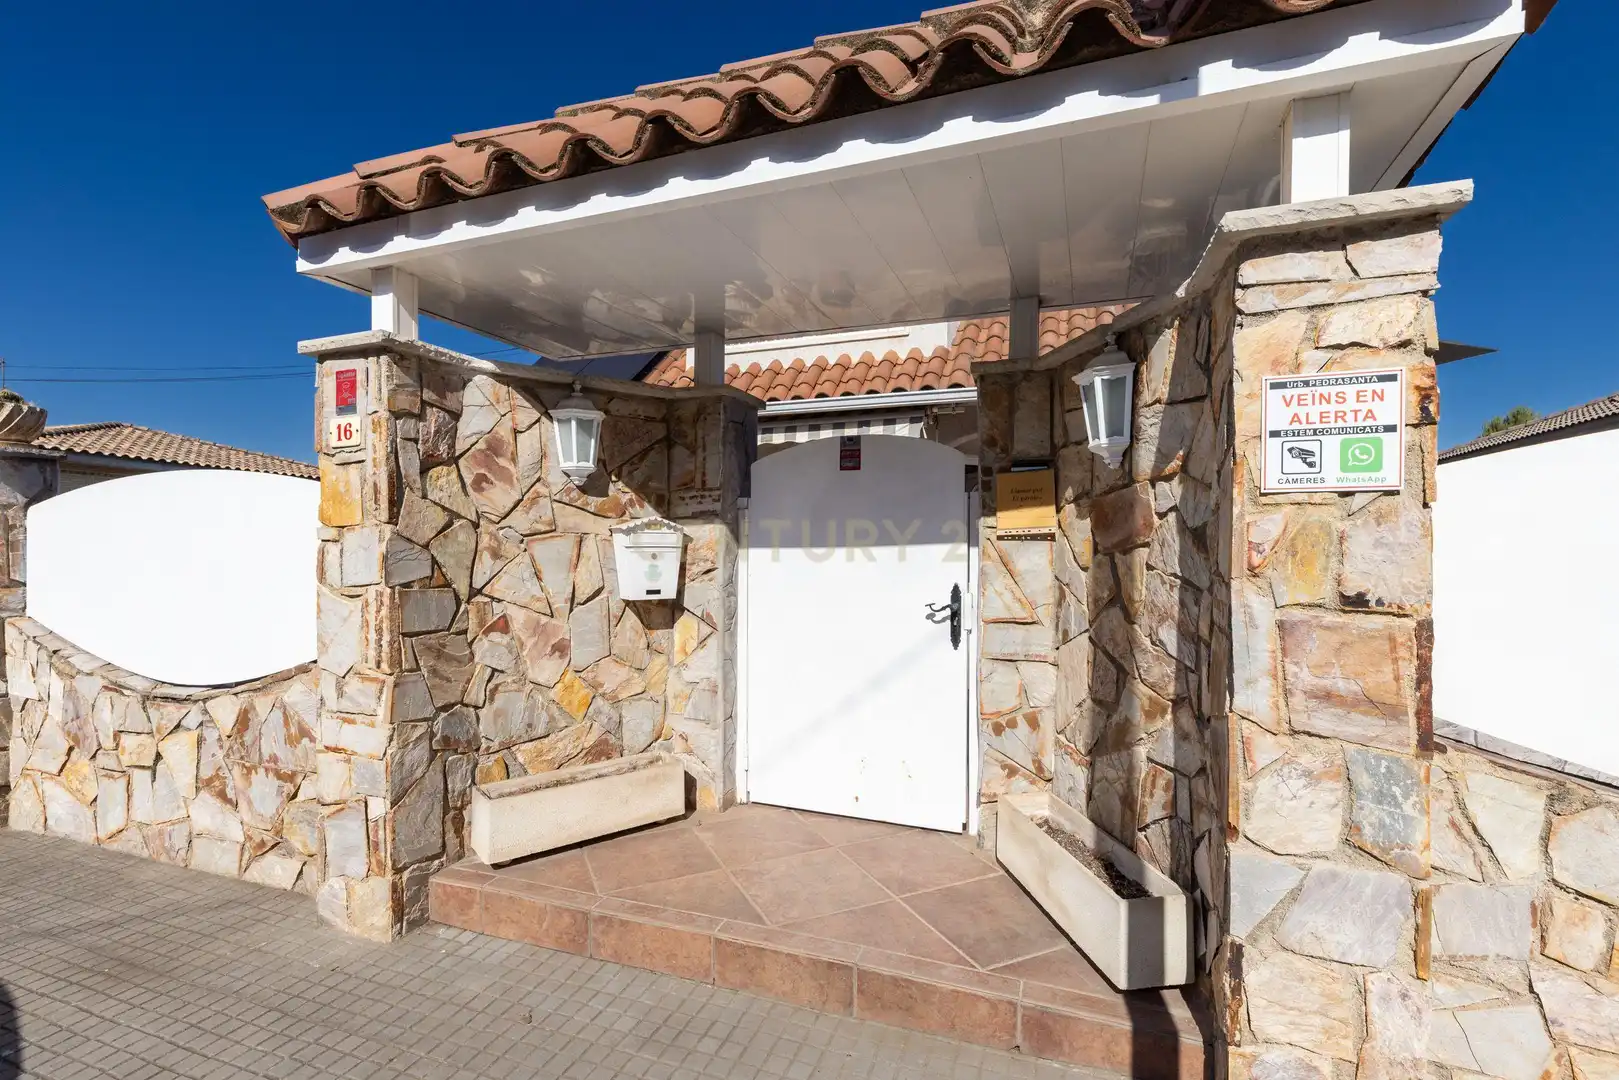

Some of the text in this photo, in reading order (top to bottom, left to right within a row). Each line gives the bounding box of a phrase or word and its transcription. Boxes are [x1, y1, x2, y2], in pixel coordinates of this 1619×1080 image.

[1286, 375, 1379, 388] Urb. PEDRASANTA
[1282, 388, 1385, 408] VEÏNS EN
[1288, 408, 1377, 426] ALERTA
[336, 422, 353, 442] 16
[1280, 425, 1384, 437] ESTEM COMUNICATS
[1336, 475, 1387, 484] WhatsApp
